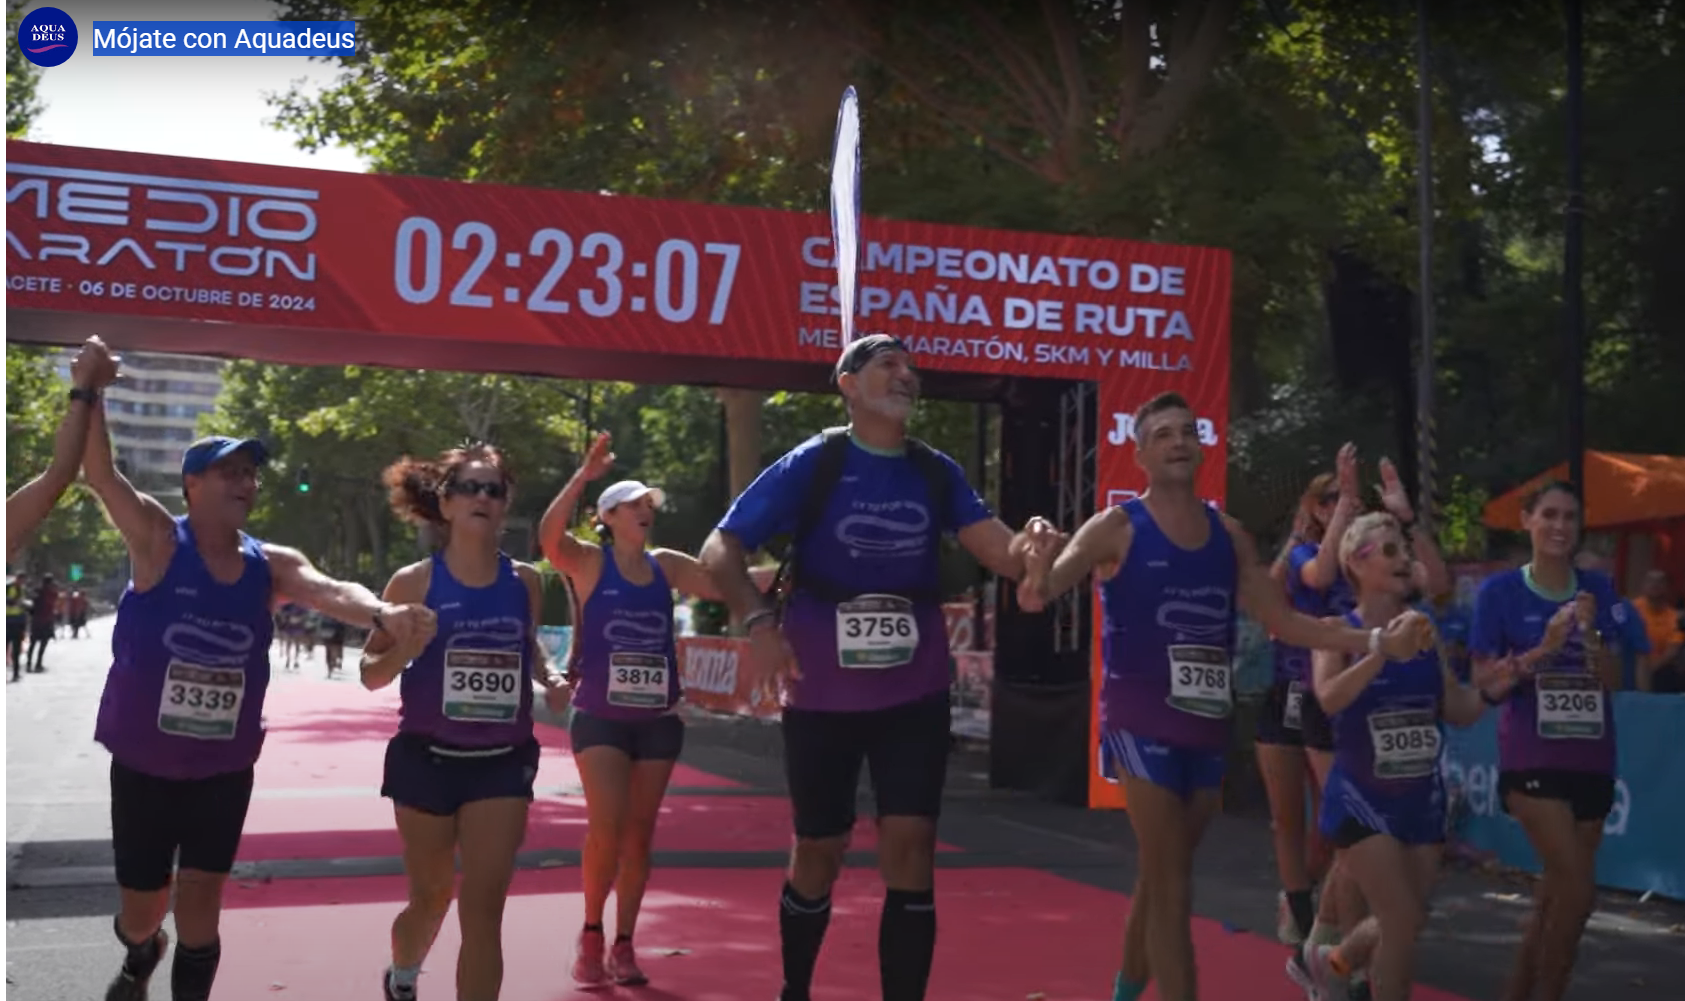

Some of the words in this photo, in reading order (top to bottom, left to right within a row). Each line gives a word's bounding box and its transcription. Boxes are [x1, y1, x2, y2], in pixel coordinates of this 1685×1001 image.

[394, 217, 741, 324] 02:23:07
[802, 236, 1119, 290] CMPEONATO
[1130, 263, 1185, 295] DE
[79, 281, 104, 296] 06
[111, 283, 136, 298] DE
[142, 285, 232, 305] OCTUBRE
[238, 292, 263, 307] DE
[269, 295, 315, 311] 2024
[1004, 297, 1063, 331] DE
[1075, 303, 1194, 341] RUTA
[1035, 344, 1089, 365] 5KM
[1097, 348, 1113, 365] Y
[1120, 350, 1193, 371] MILLA
[846, 617, 911, 638] 3756
[450, 671, 515, 694] 3690
[616, 668, 664, 685] 3814
[1179, 665, 1226, 689] 3768
[169, 684, 237, 711] 3339
[1544, 693, 1598, 712] 3206
[1380, 729, 1438, 751] 3085
